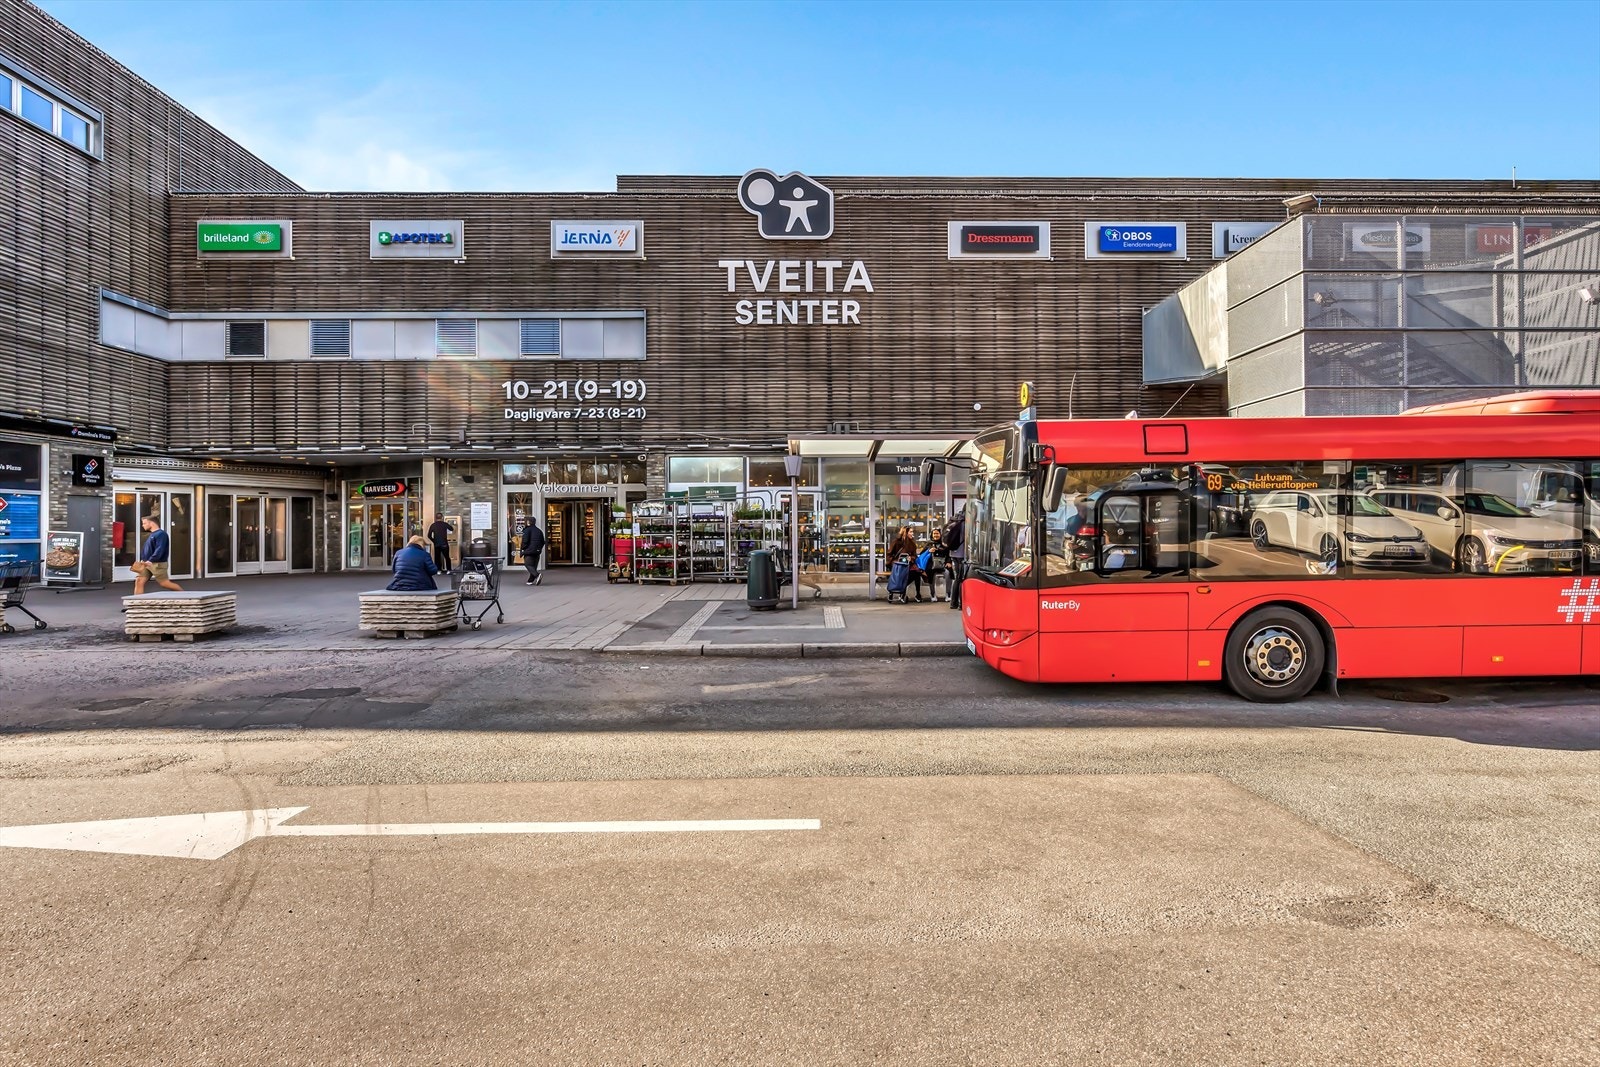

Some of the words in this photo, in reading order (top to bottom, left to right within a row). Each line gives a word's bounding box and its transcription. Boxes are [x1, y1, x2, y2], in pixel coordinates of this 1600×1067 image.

[203, 233, 249, 243] brilleland
[967, 233, 1034, 243] Dressmann
[1122, 232, 1152, 241] OBOS
[718, 260, 874, 293] TVEITA
[735, 300, 861, 325] SENTER
[504, 408, 571, 421] Dagligvare
[896, 465, 917, 473] Tveita
[1207, 474, 1222, 490] 69
[1255, 473, 1293, 482] Lutvann
[364, 485, 397, 493] NARVESEN
[534, 482, 608, 493] Velkommen
[1248, 481, 1318, 490] Hellerudtoppen
[1041, 600, 1081, 611] RuterBy
